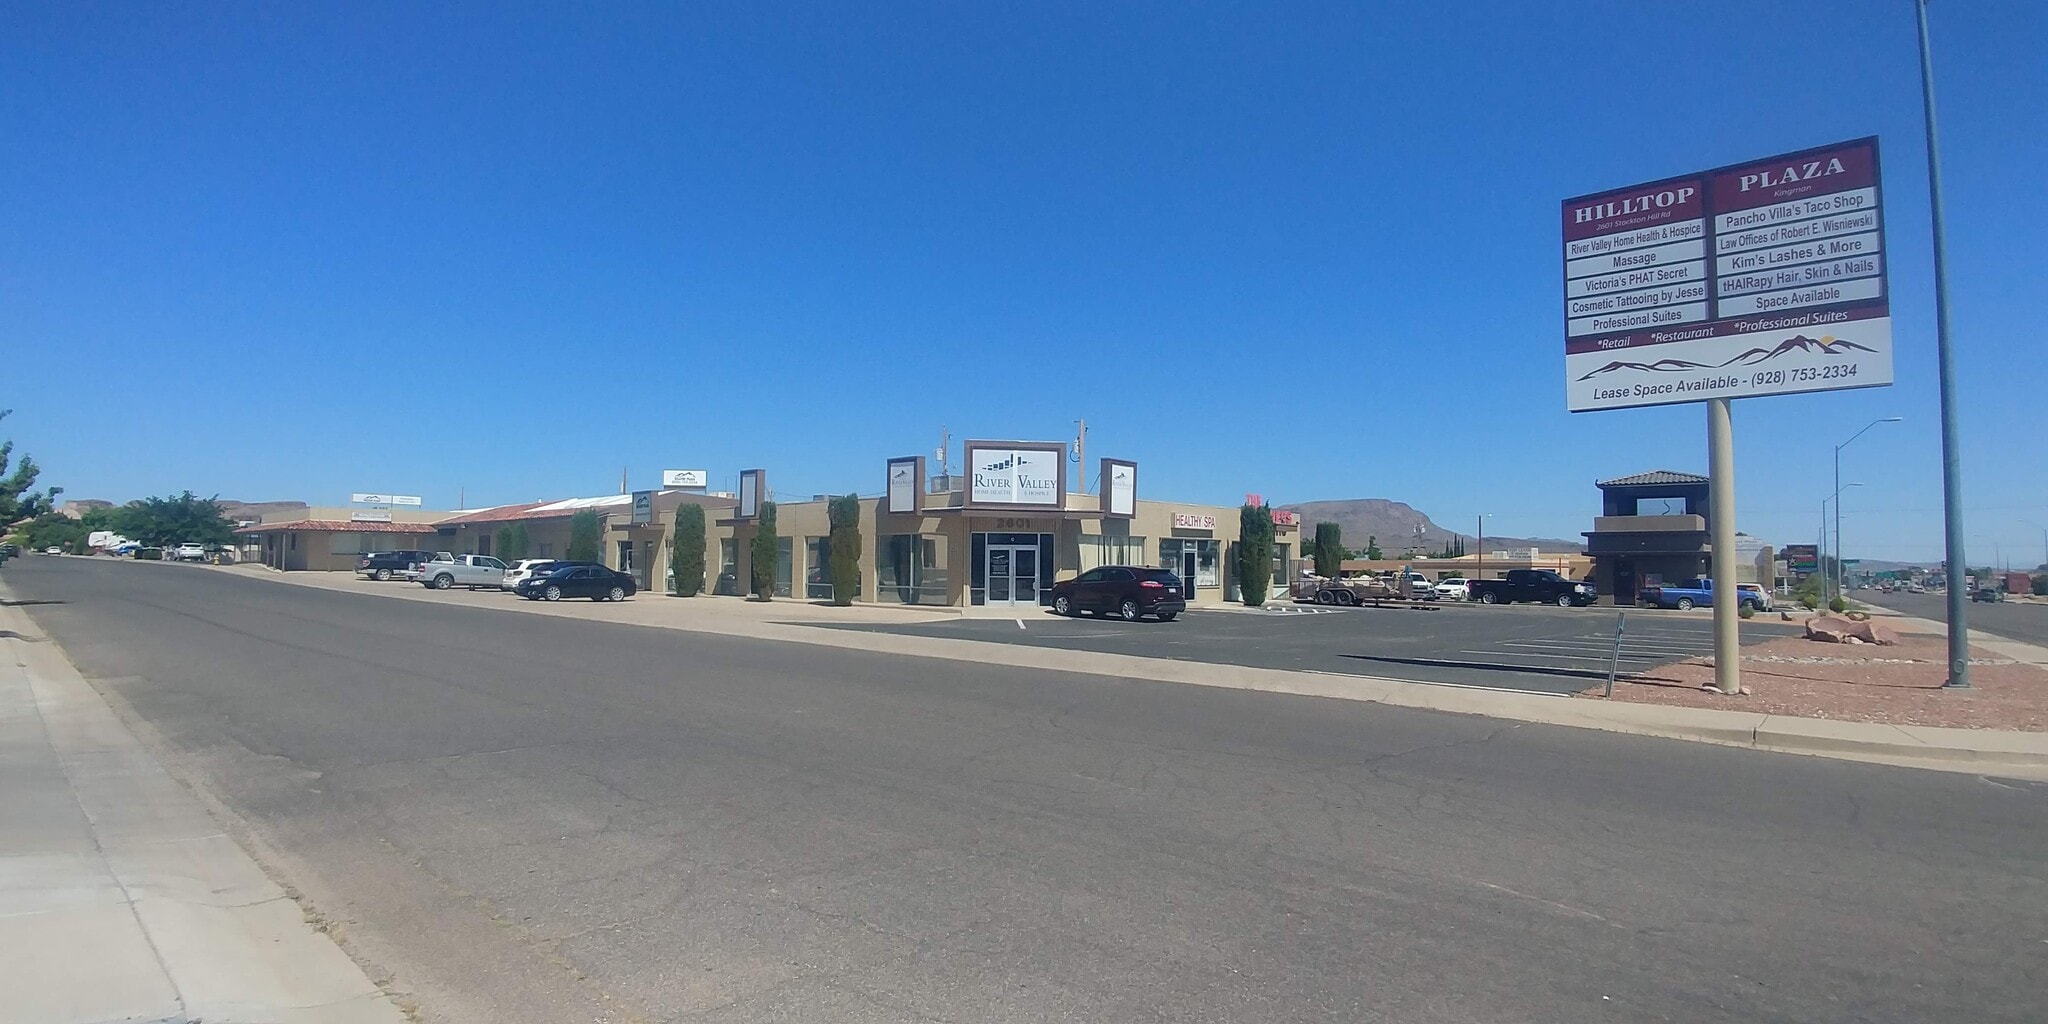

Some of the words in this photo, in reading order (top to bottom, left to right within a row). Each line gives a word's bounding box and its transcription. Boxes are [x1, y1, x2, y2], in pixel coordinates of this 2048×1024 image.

[1740, 157, 1846, 192] PLAZA
[1773, 184, 1812, 198] Kingman
[1575, 187, 1695, 224] HILLTOP
[1726, 211, 1766, 228] Pancho
[1768, 205, 1801, 219] Villa's
[1804, 200, 1831, 213] Taco
[1833, 194, 1863, 208] Shop
[1596, 221, 1613, 231] 2601
[1614, 216, 1646, 227] Stockton
[1647, 212, 1660, 221] Hill
[1661, 210, 1671, 219] Rd
[1720, 239, 1737, 250] Law
[1738, 233, 1768, 247] Offices
[1770, 229, 1779, 241] of
[1781, 224, 1810, 239] Robert
[1812, 223, 1820, 235] E.
[1823, 214, 1873, 232] Wisniewski
[1571, 243, 1589, 255] River
[1591, 239, 1612, 251] Valley
[1613, 236, 1635, 248] Home
[1636, 231, 1660, 243] Health
[1661, 228, 1668, 238] &
[1669, 223, 1701, 237] Hospice
[1613, 252, 1656, 268] Massage
[1732, 254, 1765, 269] Kim's
[1769, 247, 1813, 264] Lashes
[1816, 244, 1826, 255] &
[1830, 240, 1862, 254] More
[1585, 277, 1627, 291] Victoria's
[1629, 271, 1655, 285] PHAT
[1657, 267, 1688, 281] Secret
[1723, 275, 1773, 292] tHAIRapy
[1776, 269, 1801, 284] Hair,
[1804, 266, 1830, 279] Skin
[1833, 263, 1842, 276] &
[1845, 260, 1874, 274] Nails
[1572, 298, 1614, 313] Cosmetic
[1616, 293, 1659, 307] Tattooing
[1661, 290, 1673, 303] by
[1675, 286, 1704, 299] Jesse
[1756, 295, 1788, 310] Space
[1790, 288, 1840, 305] Available
[1593, 315, 1650, 330] Professional
[1652, 310, 1682, 323] Suites
[1812, 310, 1848, 324] Suites
[1593, 386, 1630, 400] Lease
[1633, 382, 1673, 398] Space
[1676, 374, 1738, 393] Available
[1751, 369, 1786, 389] (928)
[1791, 363, 1857, 382] 753-2334
[974, 473, 1011, 488] RIVER
[1017, 474, 1057, 489] VALLEY
[1175, 514, 1203, 527] HEALTHY
[1203, 516, 1215, 528] SPA
